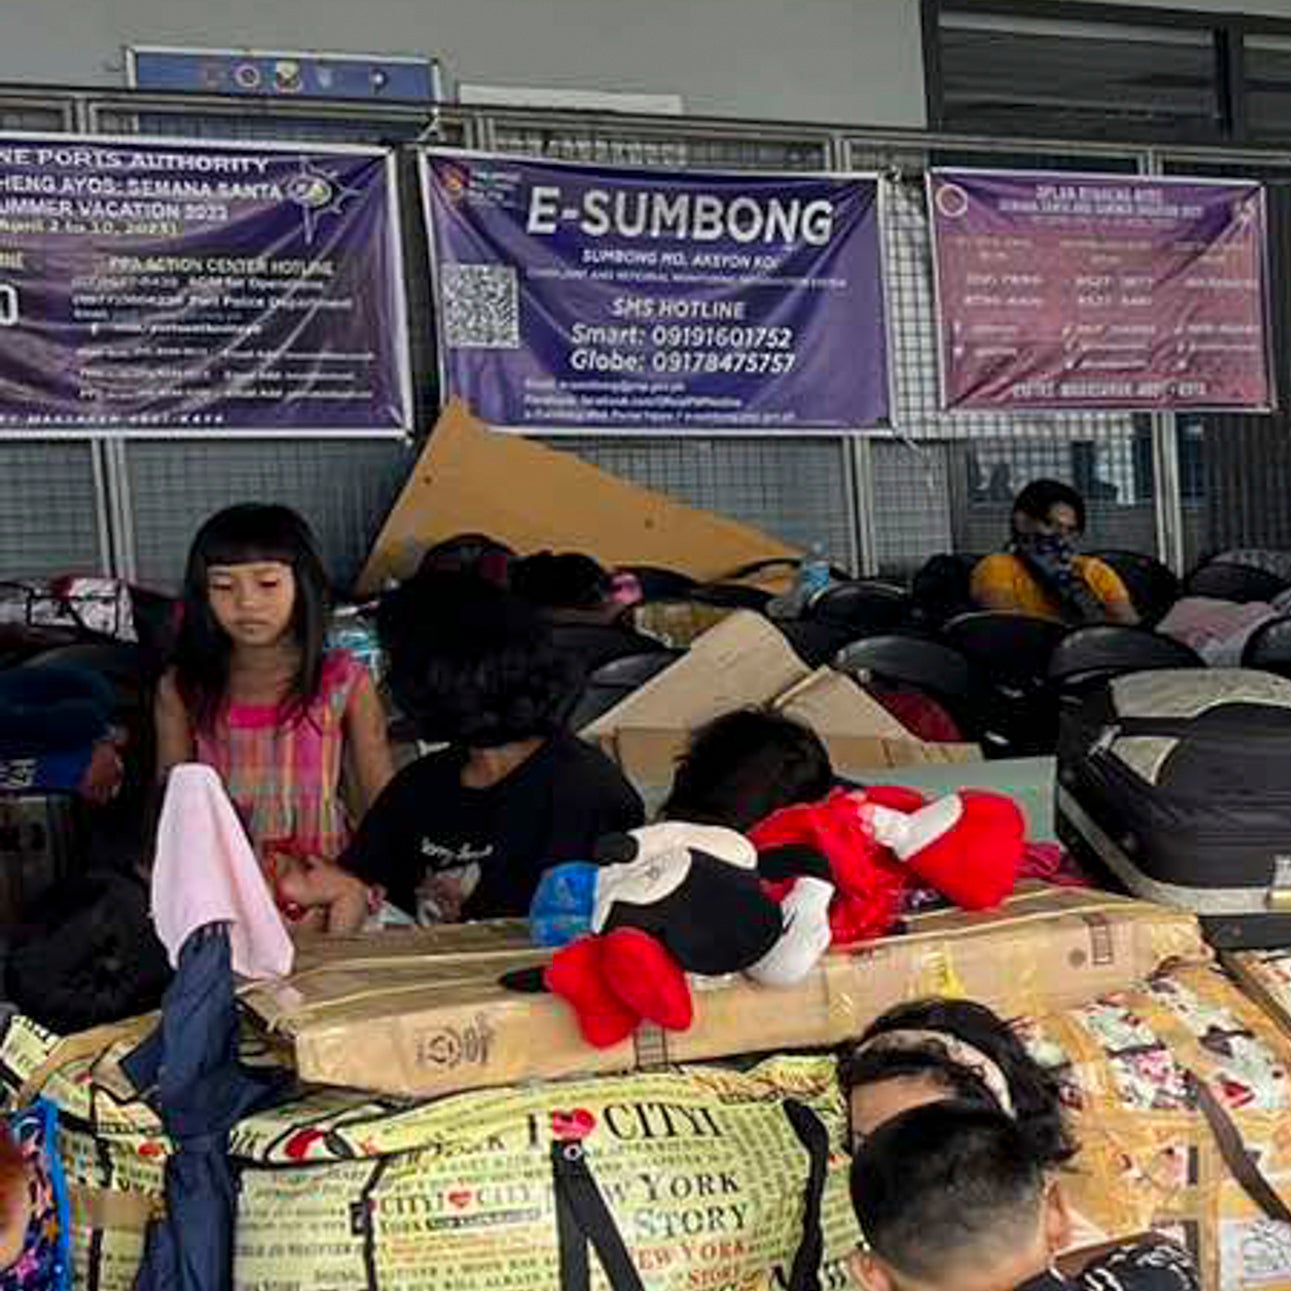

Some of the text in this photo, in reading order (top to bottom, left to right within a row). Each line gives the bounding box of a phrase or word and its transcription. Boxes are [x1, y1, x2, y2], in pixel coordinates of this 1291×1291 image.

[38, 150, 122, 167] PORTS
[130, 154, 269, 173] AUTHORITY
[129, 180, 212, 198] SEMANA
[218, 183, 283, 200] SANTA
[76, 201, 180, 219] VACATION
[526, 186, 834, 246] E-SUMBONG
[206, 258, 267, 274] CENTER
[581, 249, 658, 266] SUMBONG
[692, 254, 750, 269] AKSYON
[612, 297, 747, 321] SMS HOTLINE
[570, 322, 794, 350] Smart: 09191601752
[569, 349, 647, 371] Globe:
[638, 1171, 741, 1201] YORK
[633, 1202, 751, 1238] STORY
